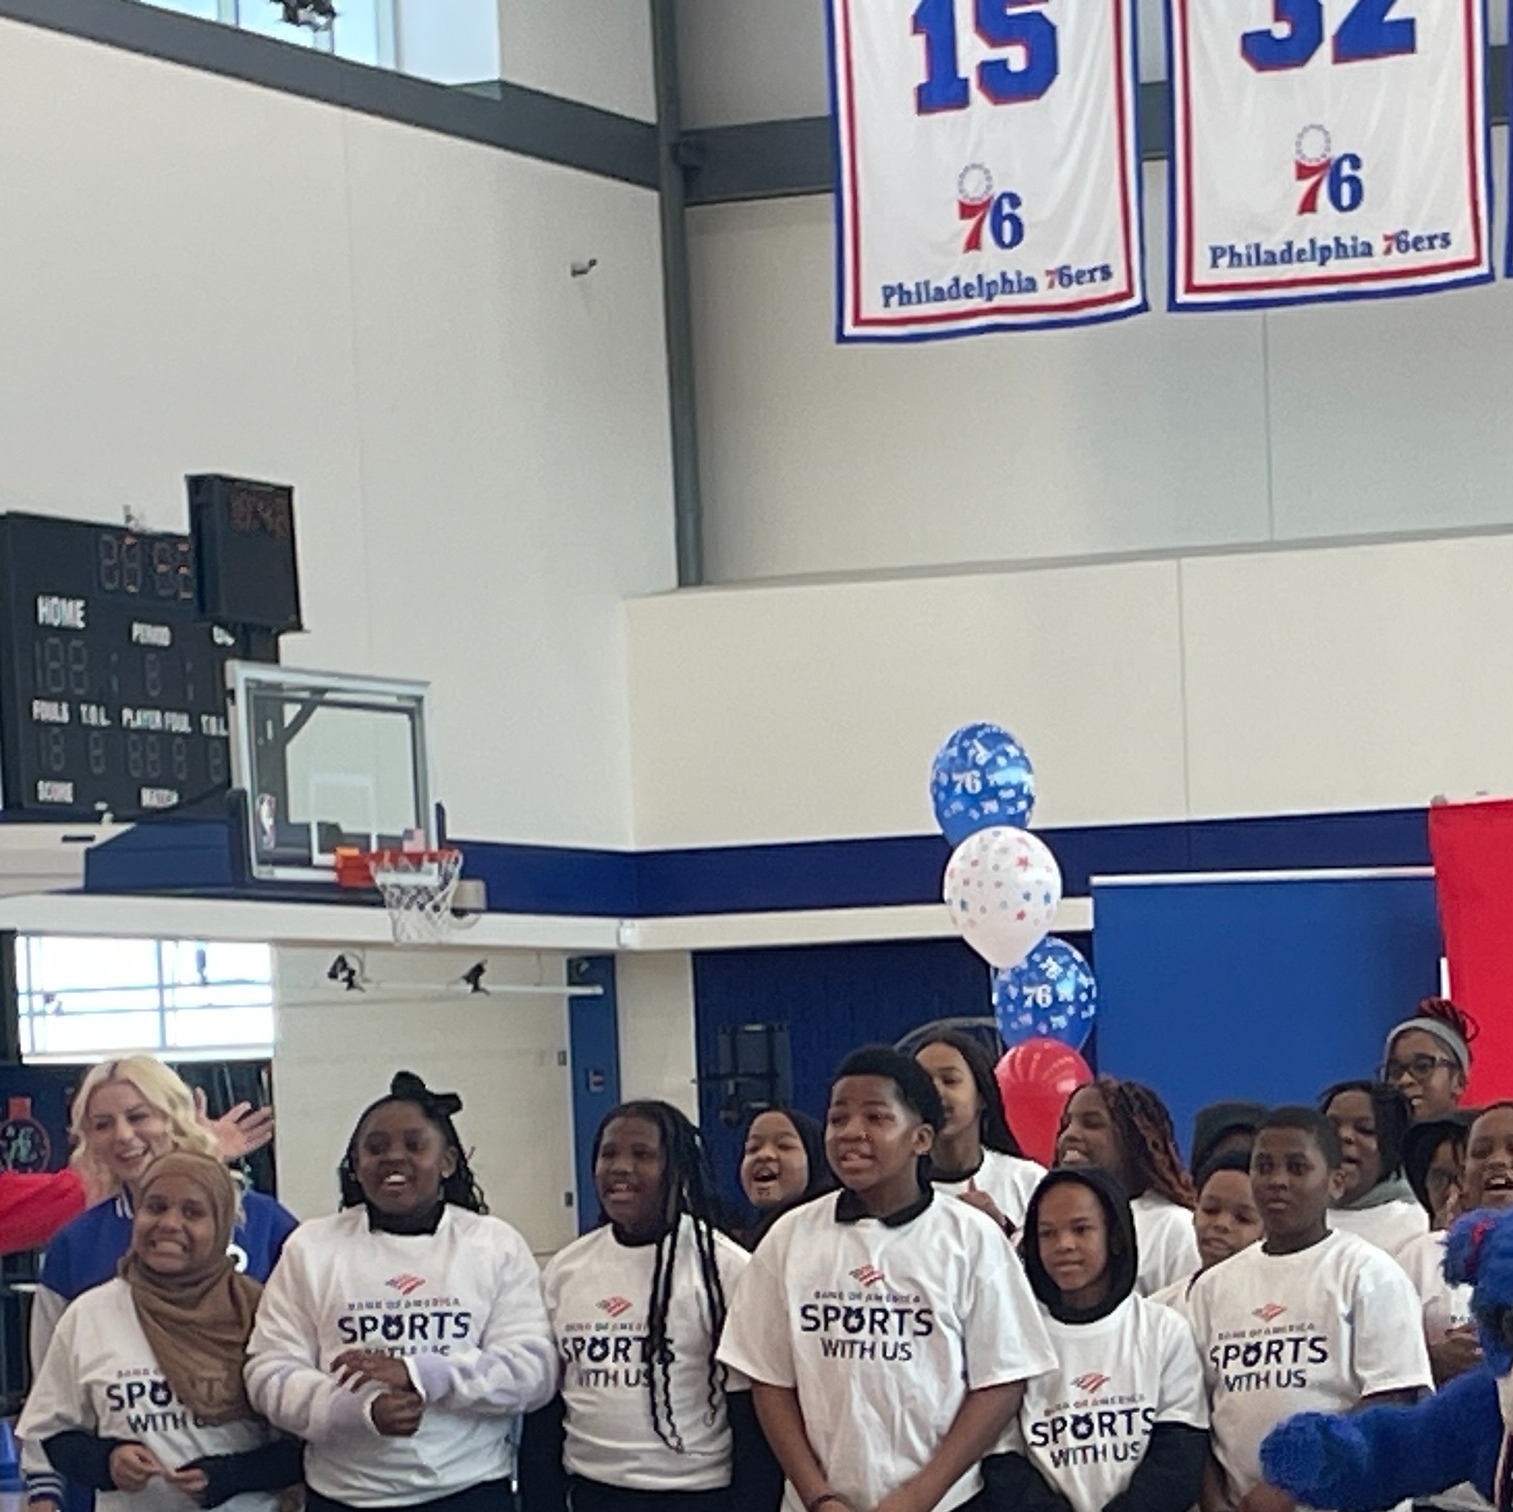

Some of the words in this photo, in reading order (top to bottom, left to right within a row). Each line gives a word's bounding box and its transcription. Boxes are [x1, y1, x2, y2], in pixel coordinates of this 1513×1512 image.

[1294, 153, 1364, 215] 76
[957, 191, 1025, 254] 76
[1208, 236, 1374, 270] Philadelphia
[1381, 229, 1453, 257] 76ers
[880, 271, 1038, 309] Philadelphia
[1044, 261, 1114, 291] 76ers
[37, 594, 87, 630] HOME
[951, 769, 983, 795] 76
[1022, 983, 1054, 1009] 76
[337, 1311, 472, 1344] SPORTS
[801, 1304, 934, 1337] SPORTS
[820, 1337, 876, 1361] WITH
[881, 1340, 913, 1362] US
[1209, 1335, 1329, 1373] SPORTS
[1275, 1368, 1307, 1389] US
[105, 1379, 175, 1412] SPO
[126, 1411, 188, 1434] WITH
[1029, 1406, 1156, 1448] SPORTS
[1049, 1443, 1108, 1469] WITH
[1111, 1441, 1141, 1462] US
